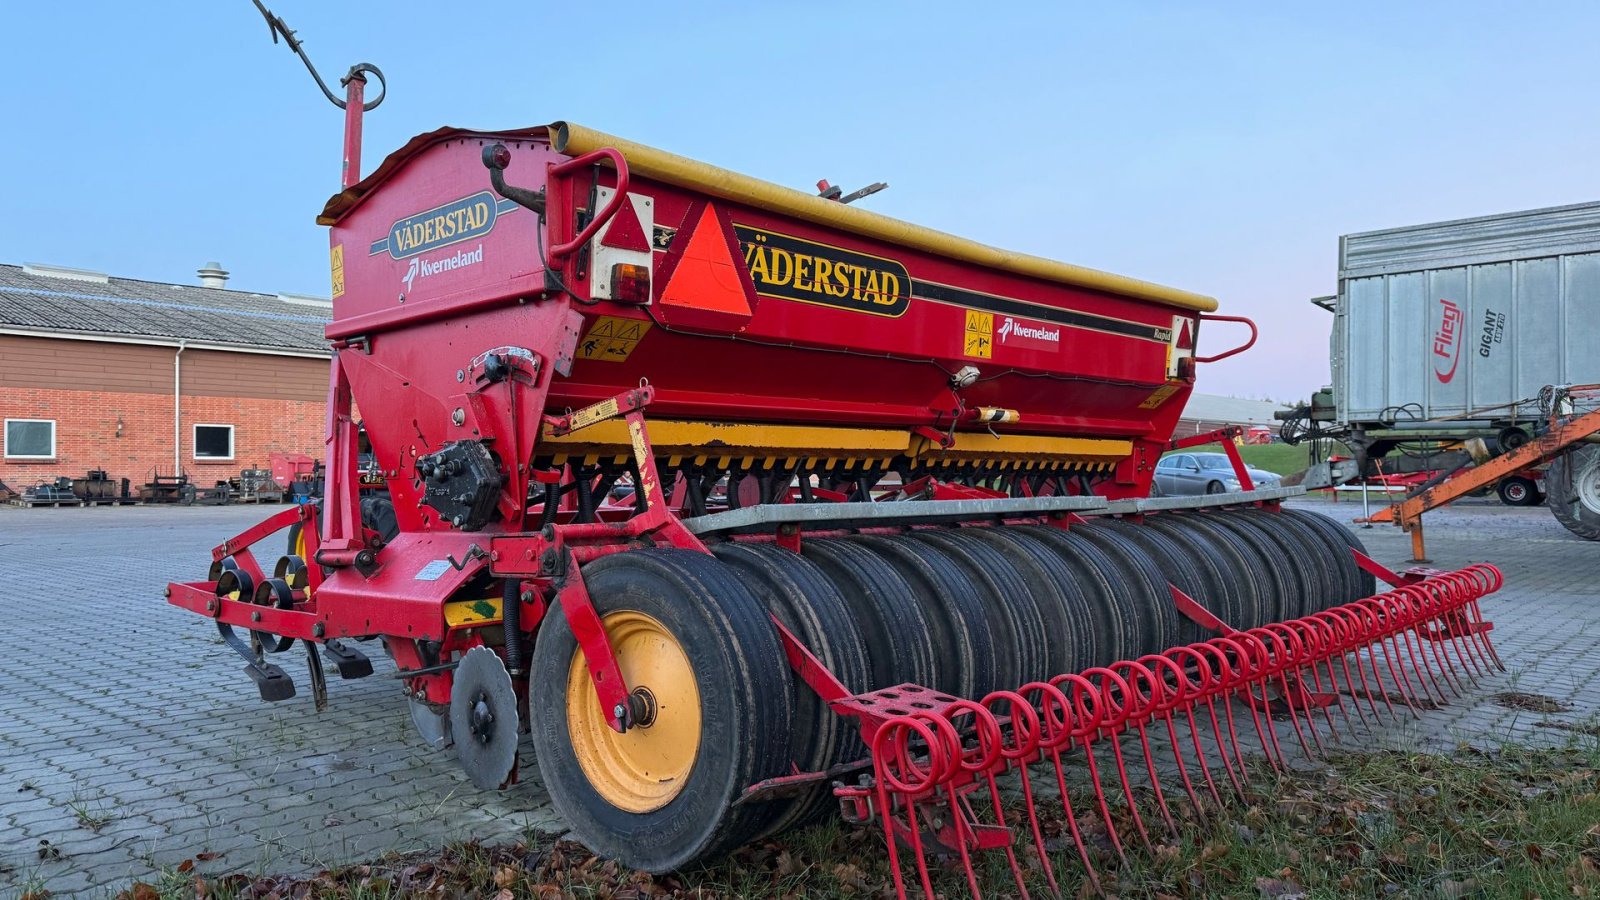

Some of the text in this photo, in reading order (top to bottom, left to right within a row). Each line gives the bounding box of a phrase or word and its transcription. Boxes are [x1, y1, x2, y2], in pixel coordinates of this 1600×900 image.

[395, 202, 489, 252] VÄDERSTAD
[420, 244, 483, 277] Kverneland
[1013, 322, 1060, 342] Kverneland
[1153, 328, 1172, 342] Rapid
[1433, 298, 1461, 358] Fliegl
[1479, 308, 1497, 358] GIGANT
